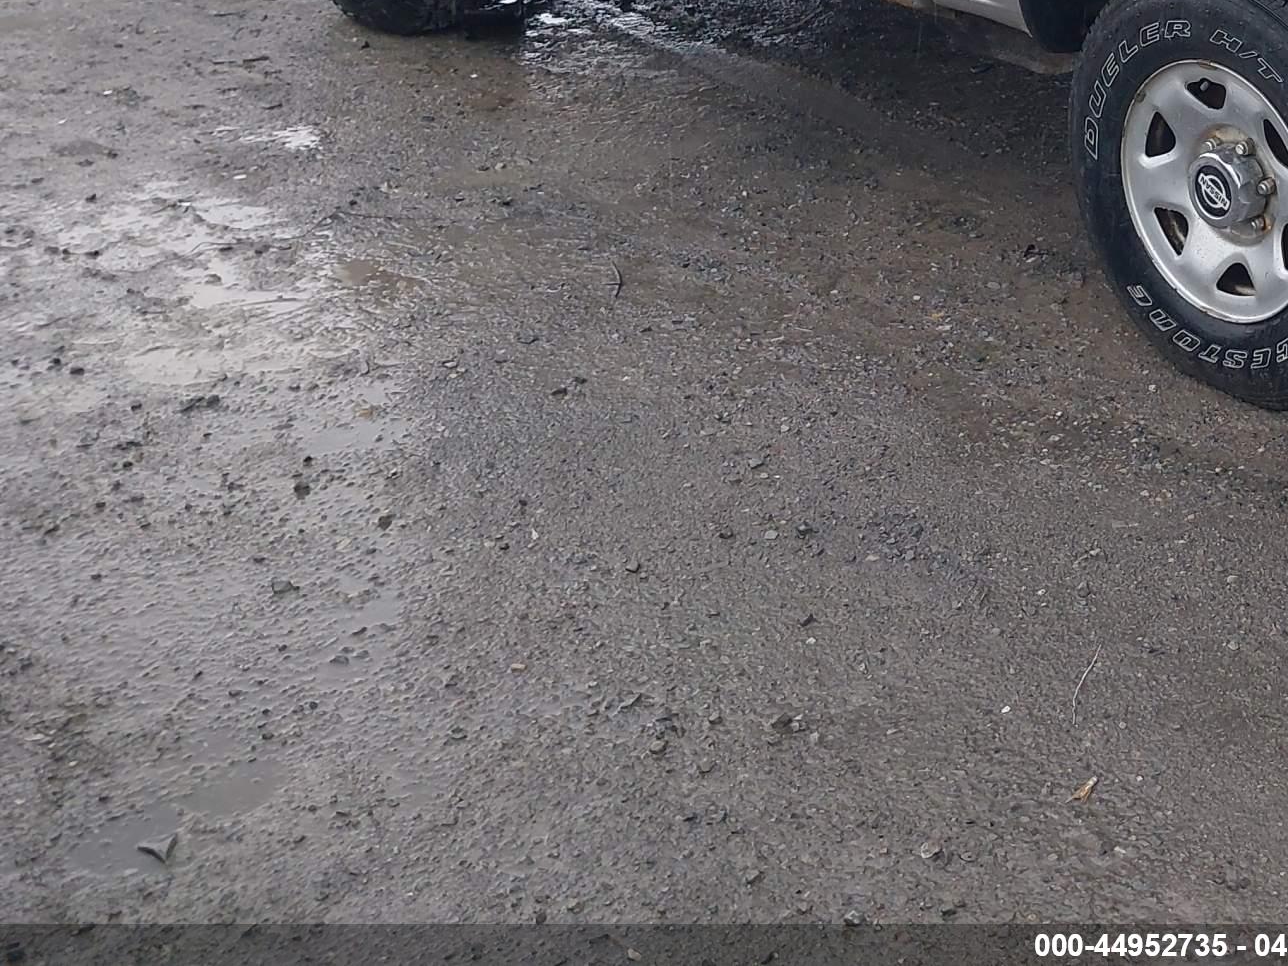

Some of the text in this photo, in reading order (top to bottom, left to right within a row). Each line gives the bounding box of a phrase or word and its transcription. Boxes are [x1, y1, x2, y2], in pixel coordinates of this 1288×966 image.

[1083, 19, 1284, 161] DUELER H/T
[1198, 172, 1230, 211] NISSAN
